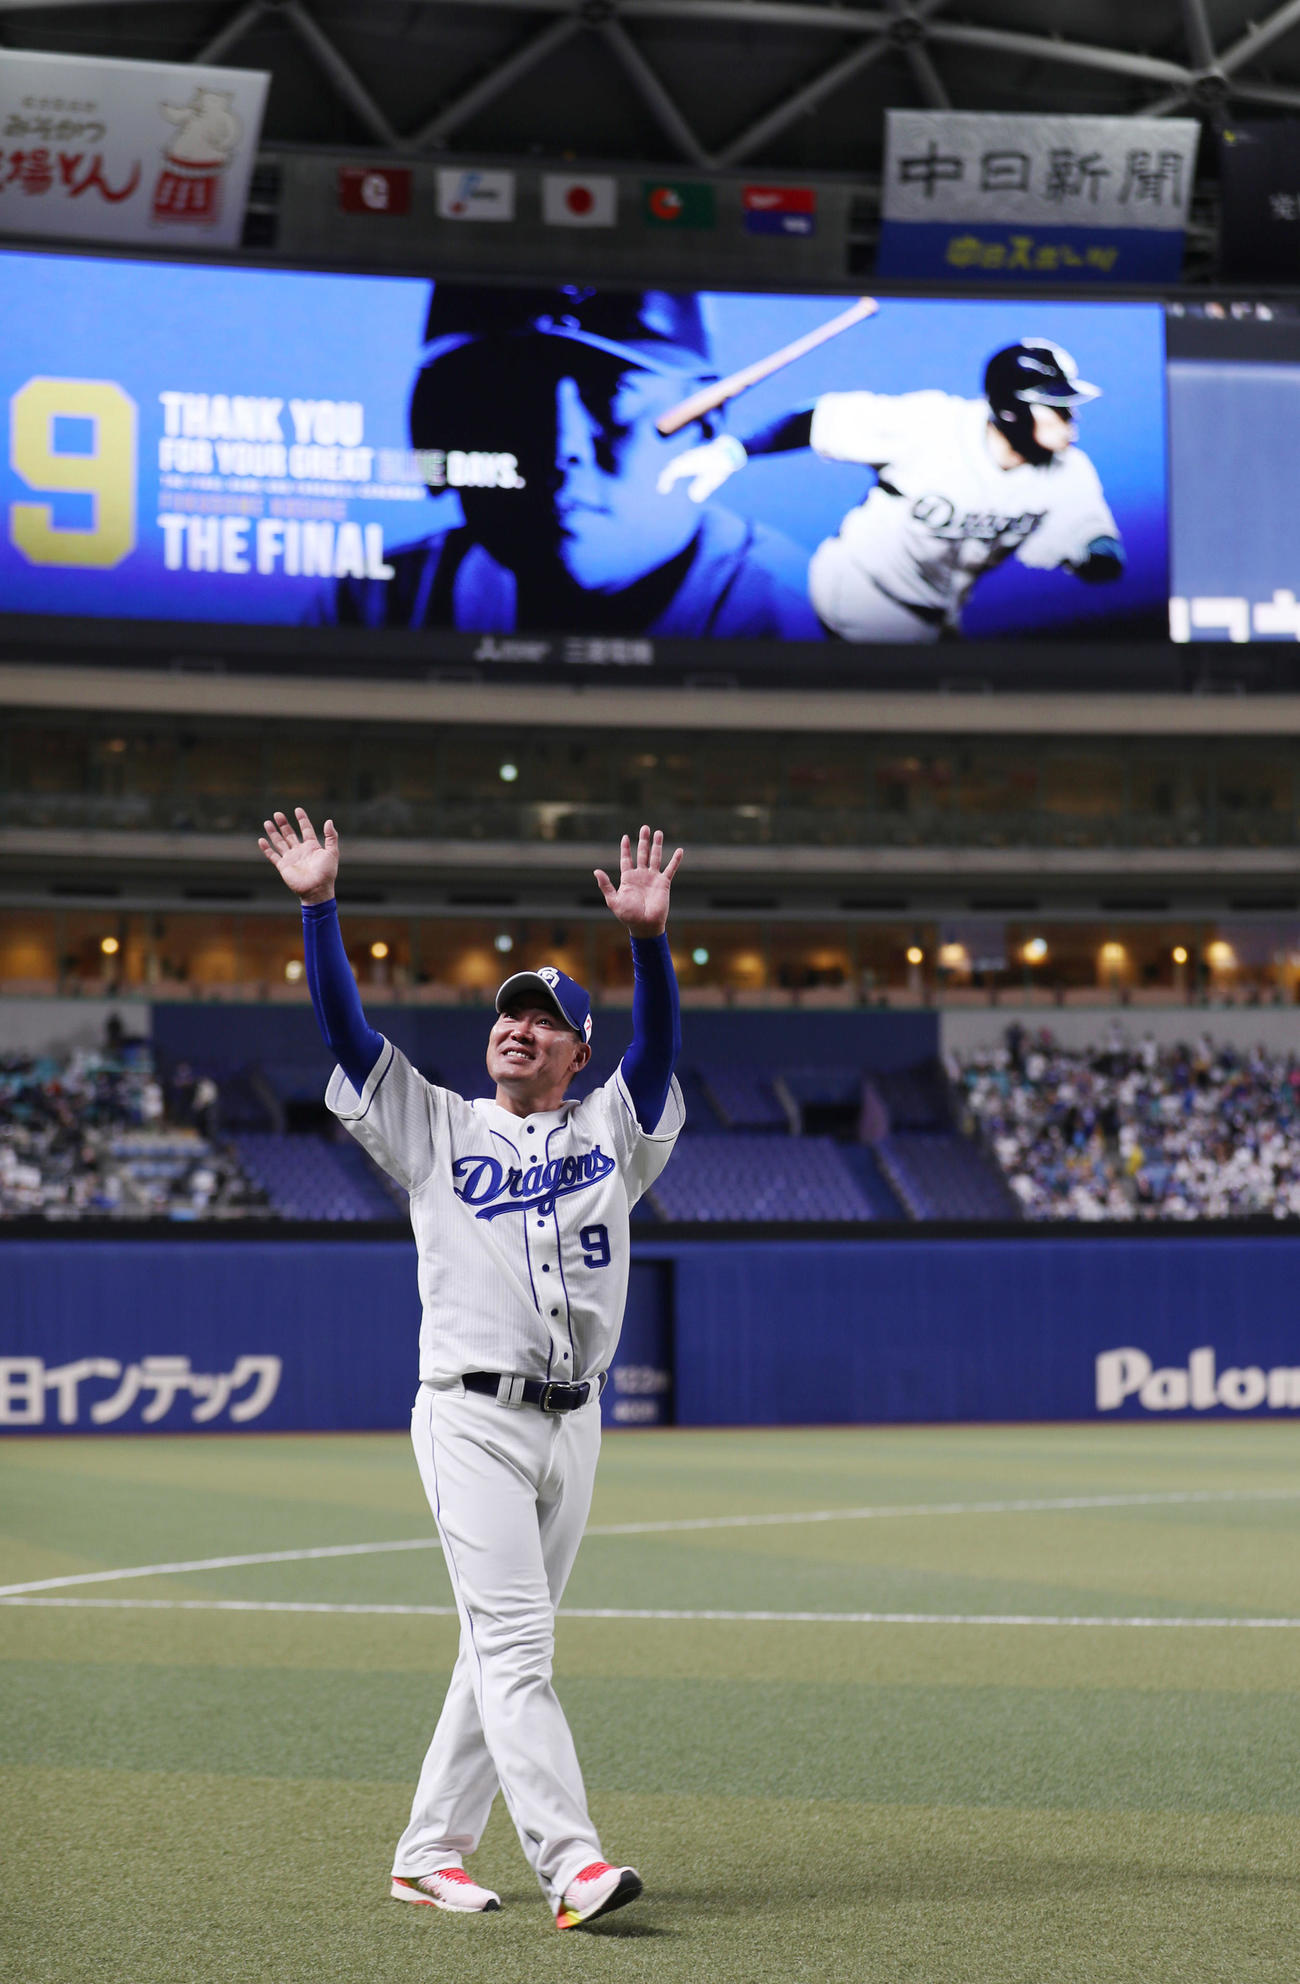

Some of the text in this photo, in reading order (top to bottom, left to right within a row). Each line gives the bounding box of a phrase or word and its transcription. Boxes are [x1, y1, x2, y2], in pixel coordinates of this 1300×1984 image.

[0, 147, 142, 205] 場とん
[898, 141, 1184, 206] 中日新聞
[159, 391, 364, 447] THANK YOU
[10, 376, 138, 569] 9
[158, 438, 213, 474] FOR
[215, 441, 287, 477] YOUR
[289, 445, 373, 482] GREAT
[157, 514, 395, 579] THE FINAL
[452, 1145, 616, 1221] Dragons
[579, 1223, 612, 1270] 9
